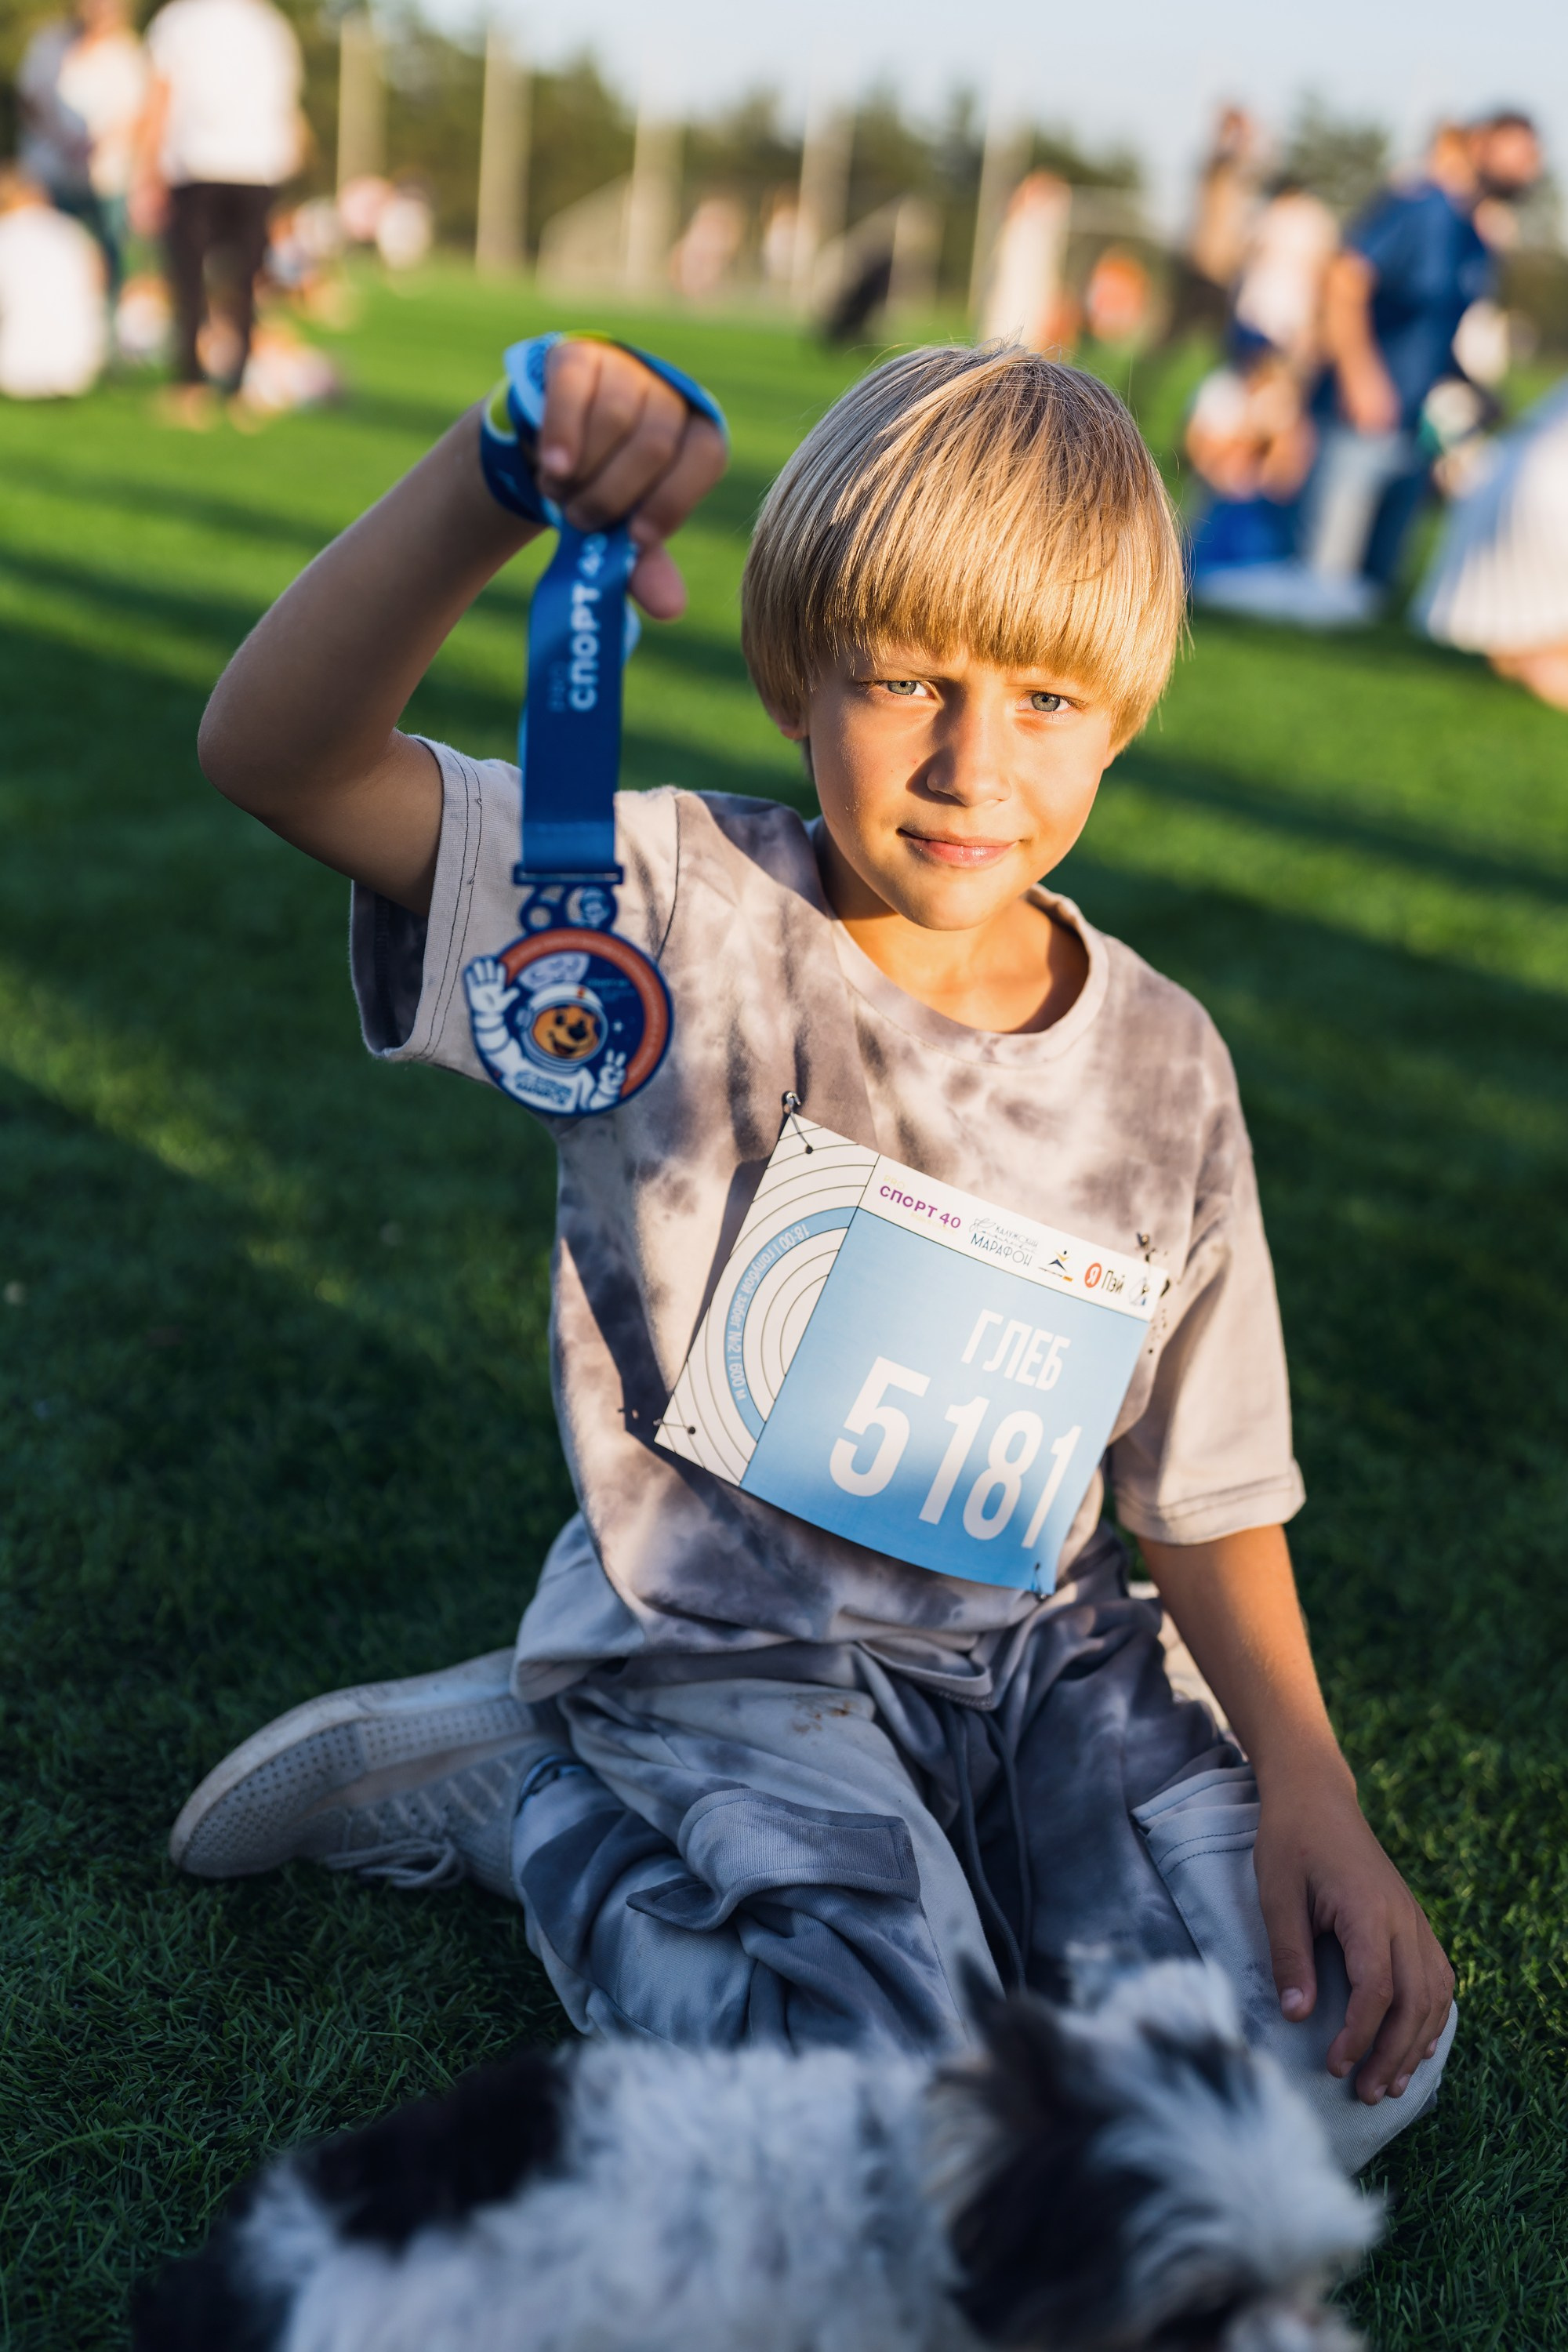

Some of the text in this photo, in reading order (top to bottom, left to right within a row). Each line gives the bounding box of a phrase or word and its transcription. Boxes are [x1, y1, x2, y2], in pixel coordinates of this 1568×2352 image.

[570, 580, 601, 711] СПОРТ
[880, 1185, 938, 1218] СПОРТ
[939, 1213, 961, 1229] 40
[779, 1224, 811, 1250] 18:00
[971, 1233, 1033, 1266] МАРАФОН
[741, 1248, 775, 1294] голубой
[1102, 1269, 1125, 1294] Пэй
[730, 1294, 748, 1329] забег
[961, 1308, 1072, 1392] ГЛЕБ
[729, 1363, 746, 1388] 600
[829, 1355, 1083, 1550] 5181
